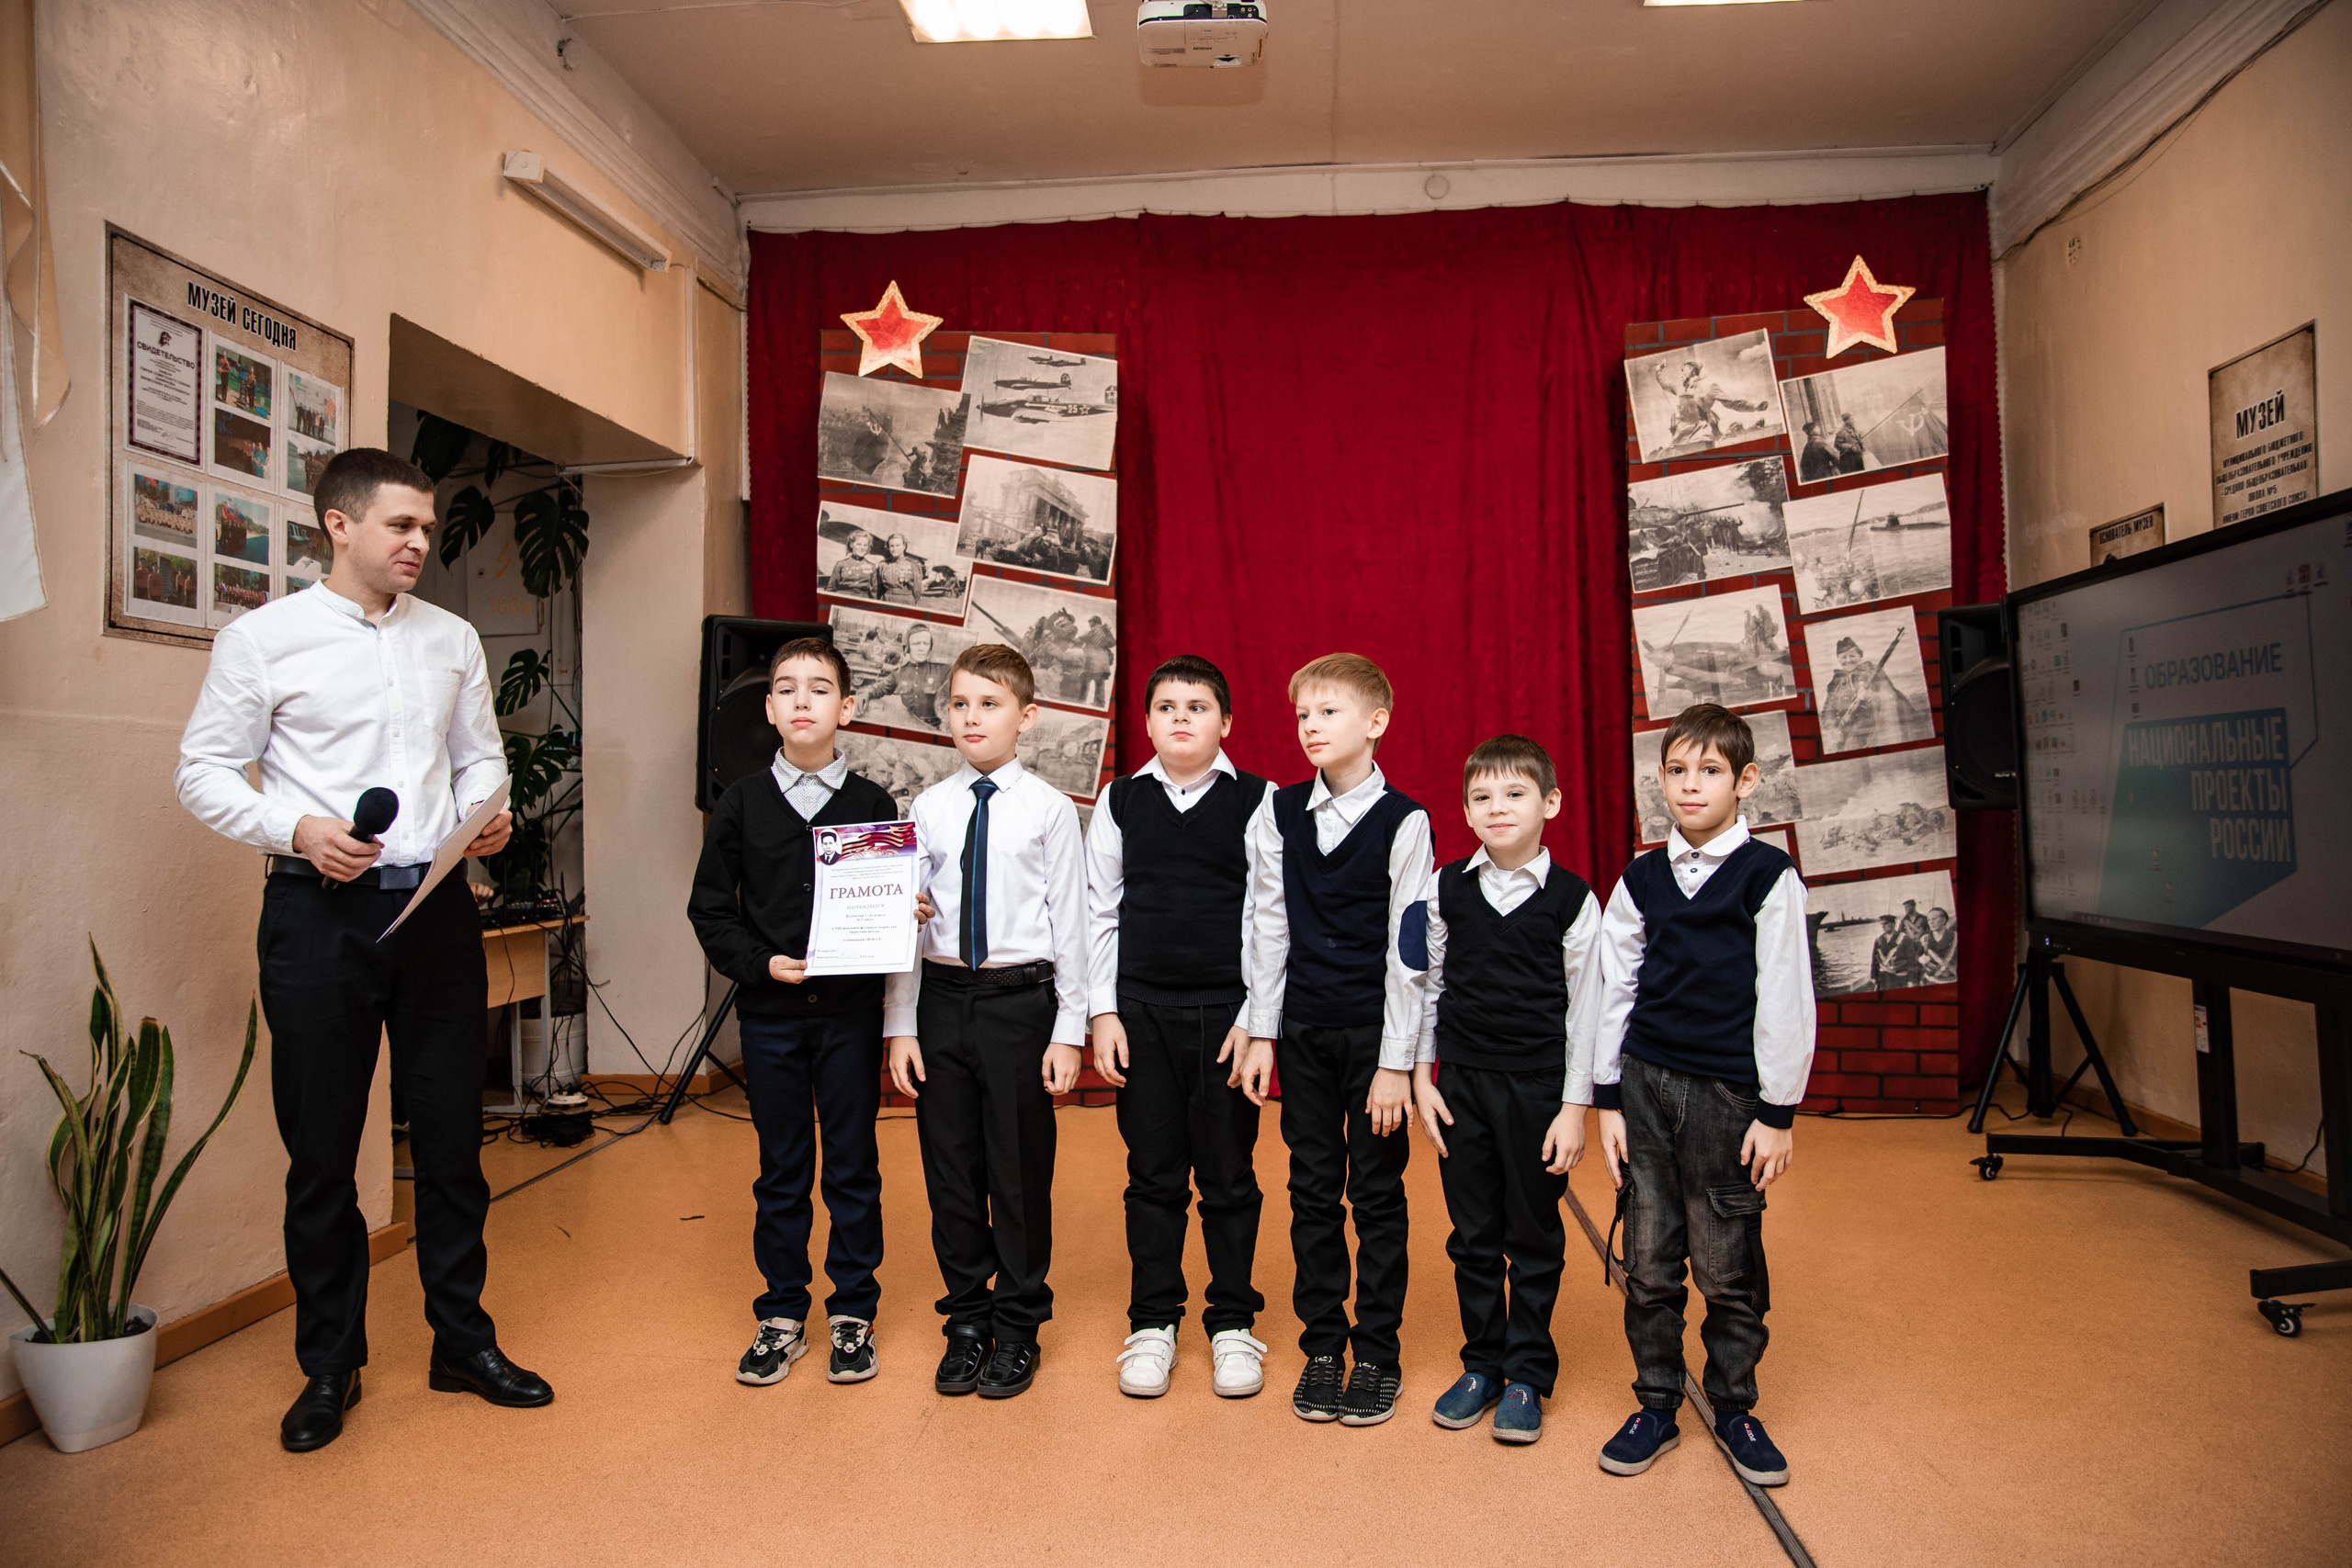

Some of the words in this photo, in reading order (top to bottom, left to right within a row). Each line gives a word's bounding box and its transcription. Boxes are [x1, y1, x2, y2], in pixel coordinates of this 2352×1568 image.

[187, 281, 237, 325] МУЗЕЙ
[243, 307, 298, 352] СЕГОДНЯ
[137, 341, 196, 369] СВИДЕТЕЛЬСТВО
[1068, 404, 1078, 413] 25
[2235, 389, 2285, 439] МУЗЕЙ
[2216, 457, 2276, 485] ОБЩЕОБРАЗОВАТЕЛЬНОГО
[2277, 443, 2312, 463] УЧРЕЖДЕНИЯ
[2222, 445, 2267, 468] МУНИЦИПАЛЬНОГО
[2267, 431, 2303, 452] БЮДЖЕТНОГО
[2246, 459, 2307, 489] ОБЩЕОБРАЗОВАТЕЛЬНАЯ
[2222, 512, 2239, 525] ИМЕНИ
[2240, 507, 2255, 519] ГЕРОЯ
[2256, 497, 2287, 514] СОВЕТСКОГО
[2289, 491, 2307, 504] СОЮЗА
[2248, 489, 2265, 502] ШКОЛА
[2099, 524, 2132, 545] ОСНОВАТЕЛЬ
[2133, 514, 2154, 533] МУЗЕЯ
[2145, 643, 2282, 690] ОБРАЗОВАНИЕ
[2128, 716, 2284, 770] НАЦИОНАЛЬНЫЕ
[2191, 768, 2288, 812] ПРОЕКТЫ
[2210, 818, 2291, 863] РОССИИ
[830, 884, 903, 899] ГРАМОТА
